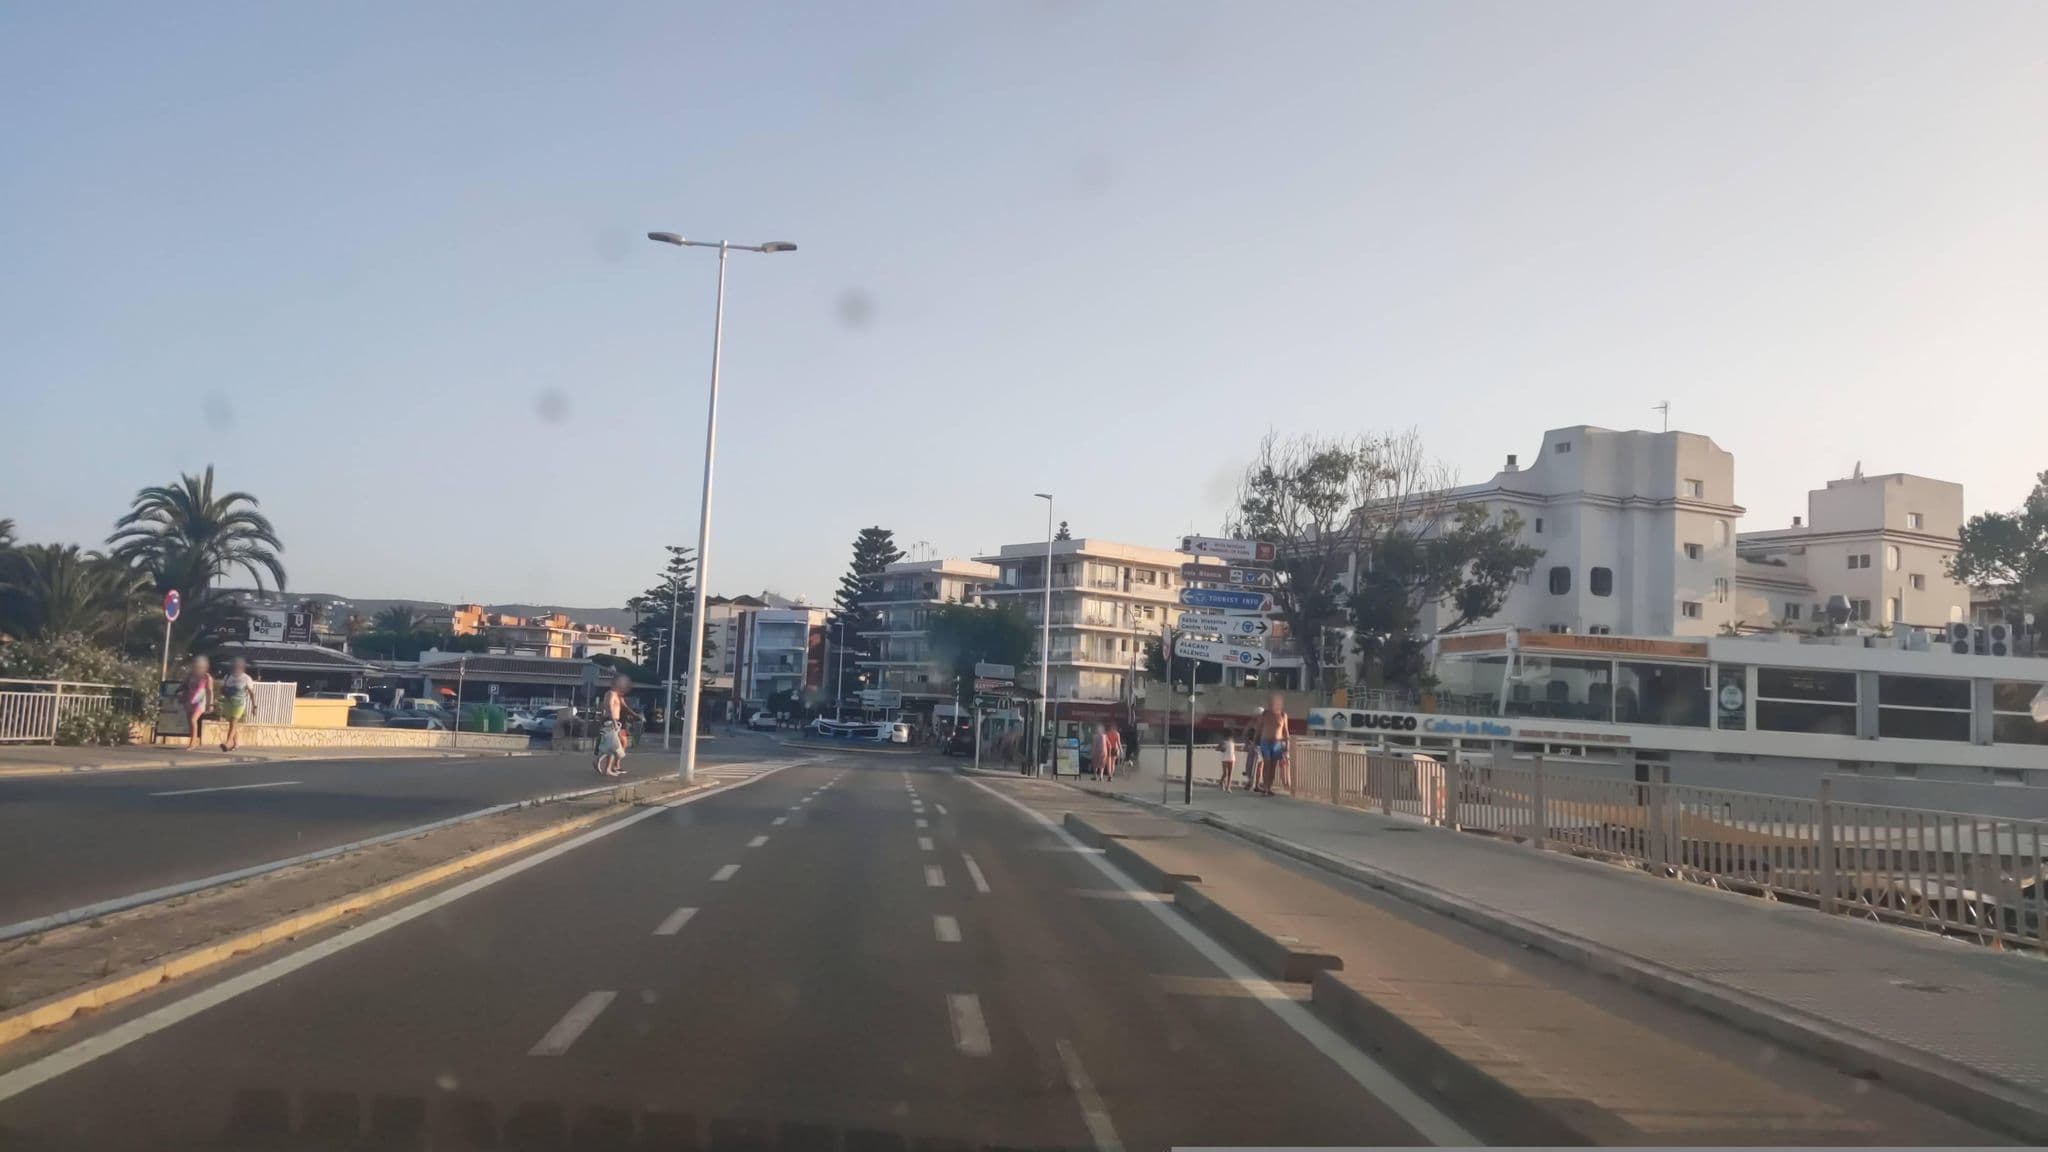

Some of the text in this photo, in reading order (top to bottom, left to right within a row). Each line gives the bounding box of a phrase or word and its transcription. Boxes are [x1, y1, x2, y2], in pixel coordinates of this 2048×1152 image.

[1208, 595, 1238, 604] TOURIST
[1180, 641, 1209, 650] ALACANT
[1574, 636, 1656, 651] MANUELITA
[1351, 713, 1417, 731] BUCEO
[1423, 718, 1463, 733] Cabo
[1481, 721, 1512, 736] Nao
